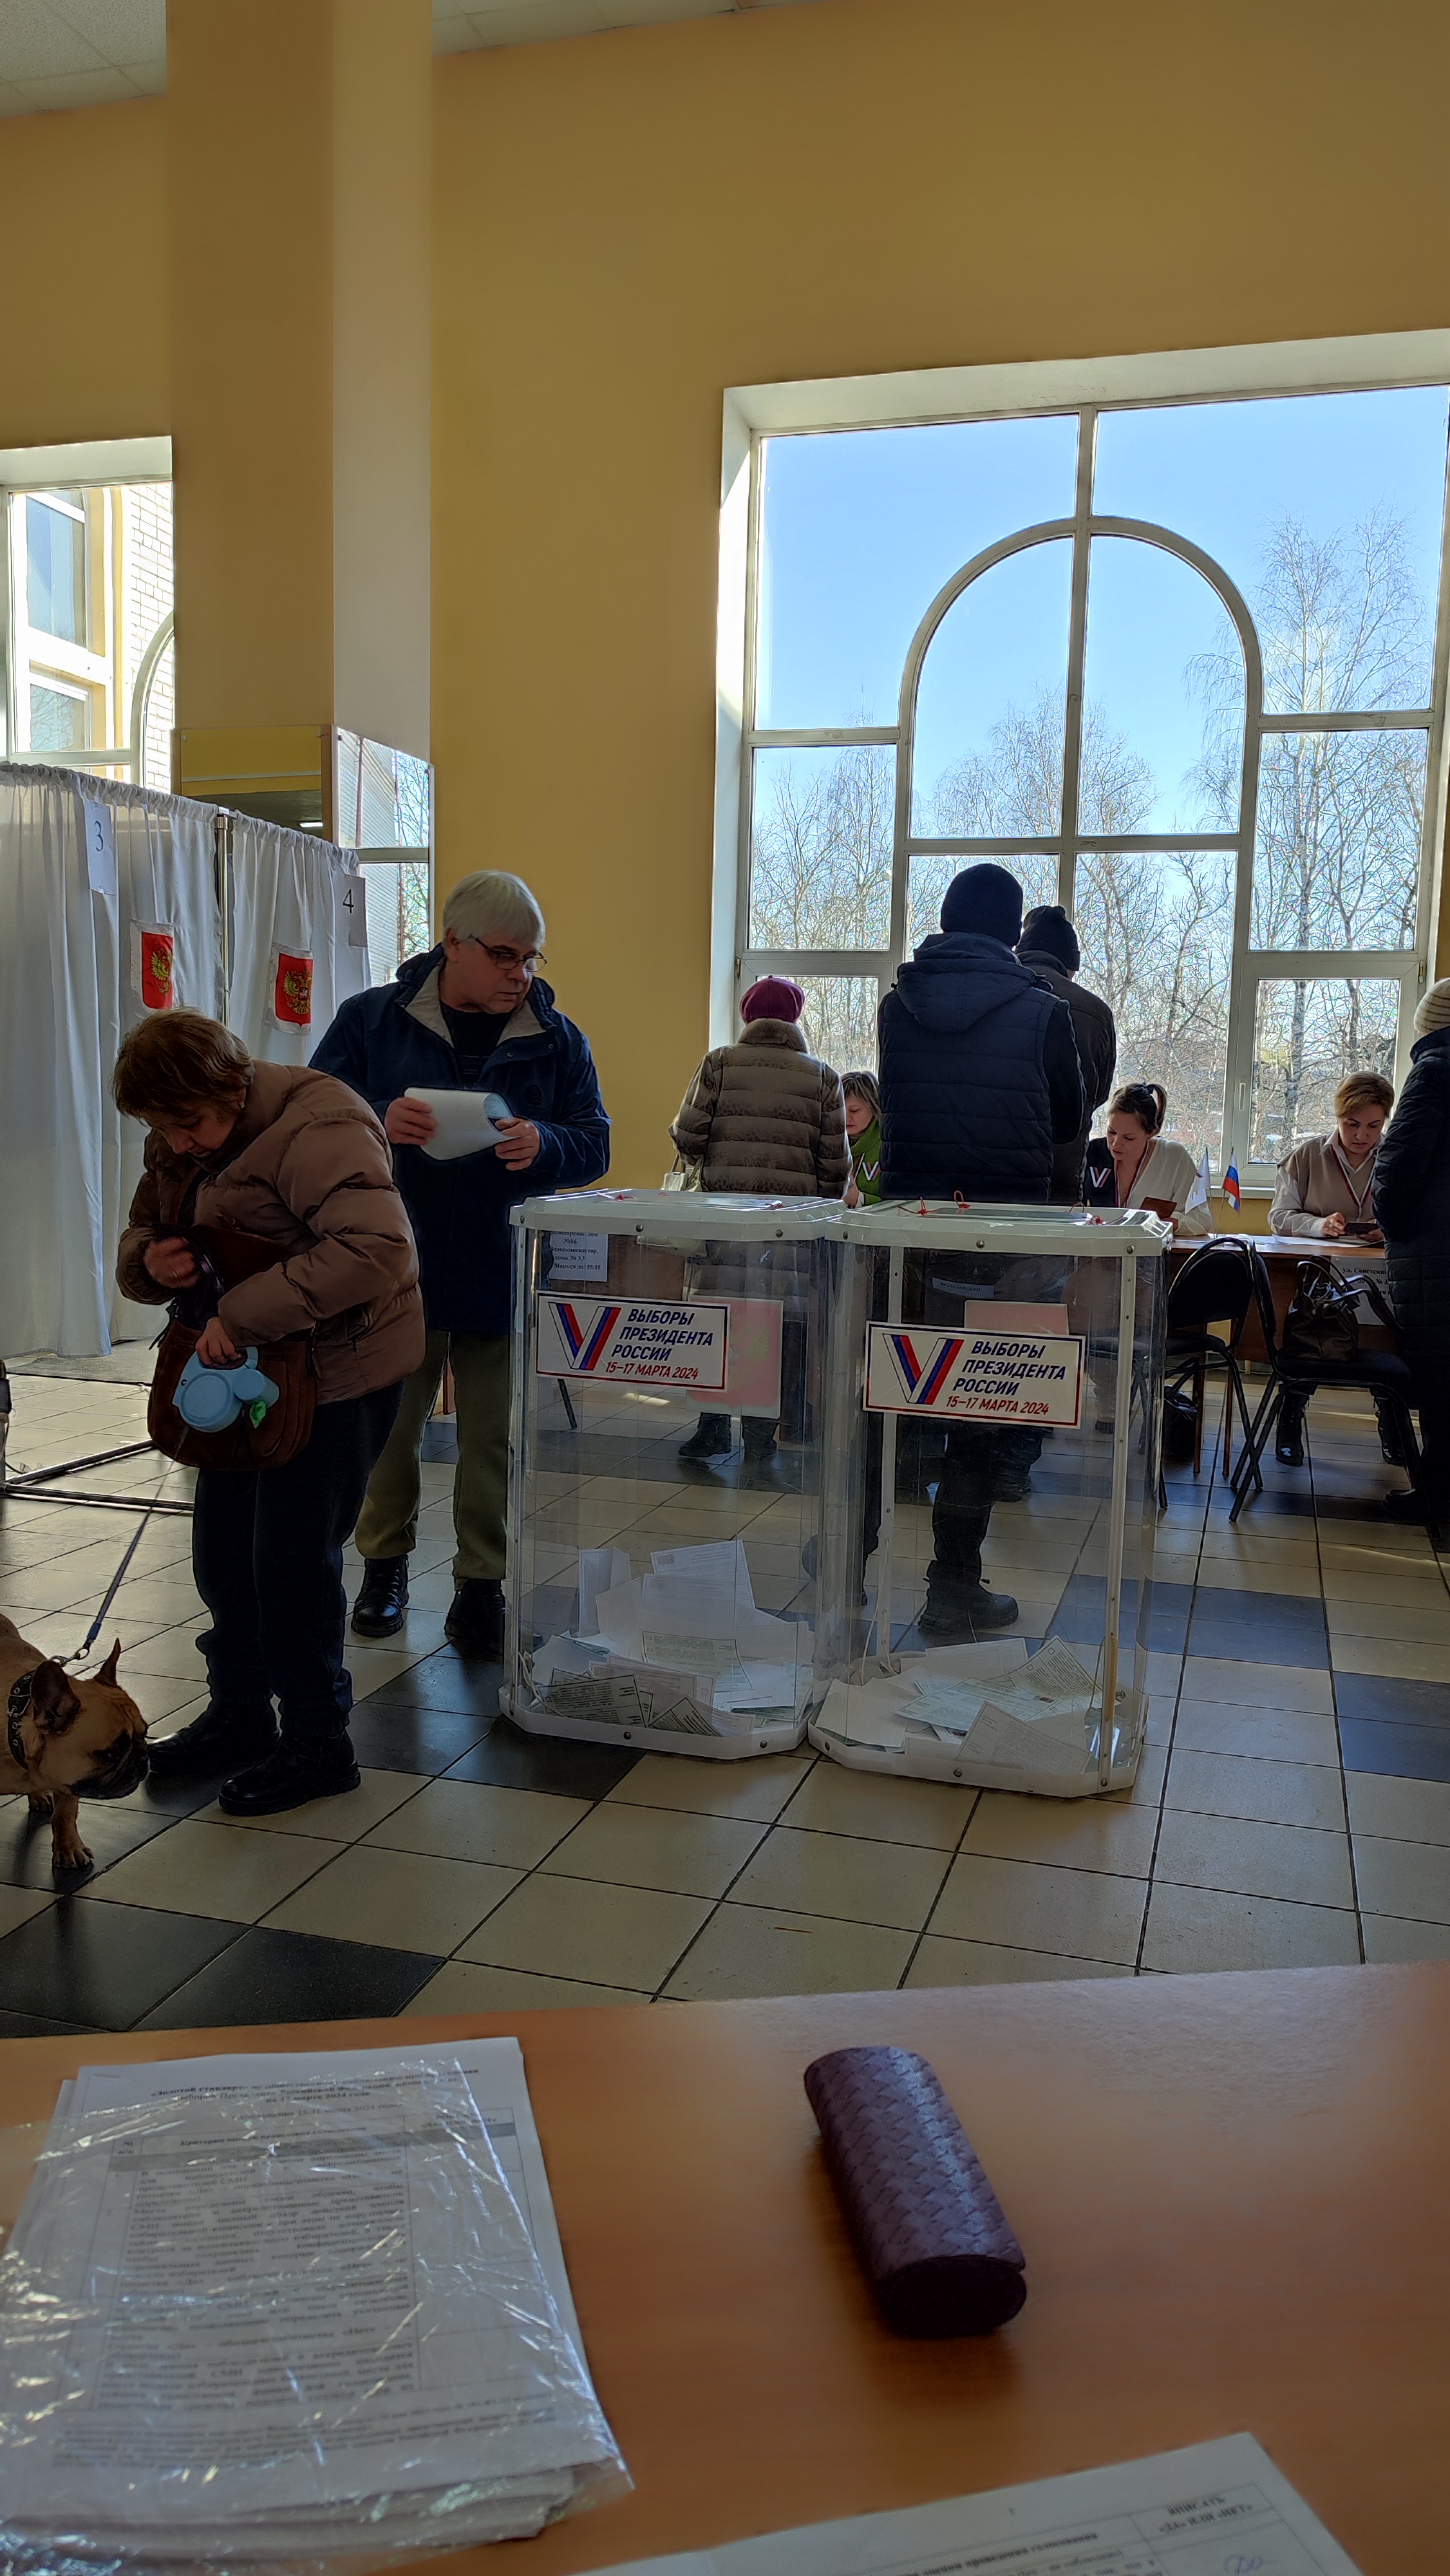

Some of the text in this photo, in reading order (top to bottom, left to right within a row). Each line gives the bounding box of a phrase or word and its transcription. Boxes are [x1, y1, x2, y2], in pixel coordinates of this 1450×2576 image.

[94, 820, 104, 852] 3
[343, 888, 355, 914] 4
[627, 1309, 695, 1326] ВЫБОРЫ
[619, 1326, 714, 1346] ПРЕЗИДЕНТА
[611, 1344, 673, 1361] РОССИИ
[971, 1340, 1046, 1359] ВЫБОРЫ
[635, 1363, 672, 1378] МАРТА
[672, 1367, 699, 1380] 2024
[961, 1359, 1066, 1380] ПРЕЗИДЕНТА
[952, 1378, 1021, 1396] РОССИИ
[979, 1397, 1019, 1413] МАРТА
[1019, 1401, 1050, 1416] 2024
